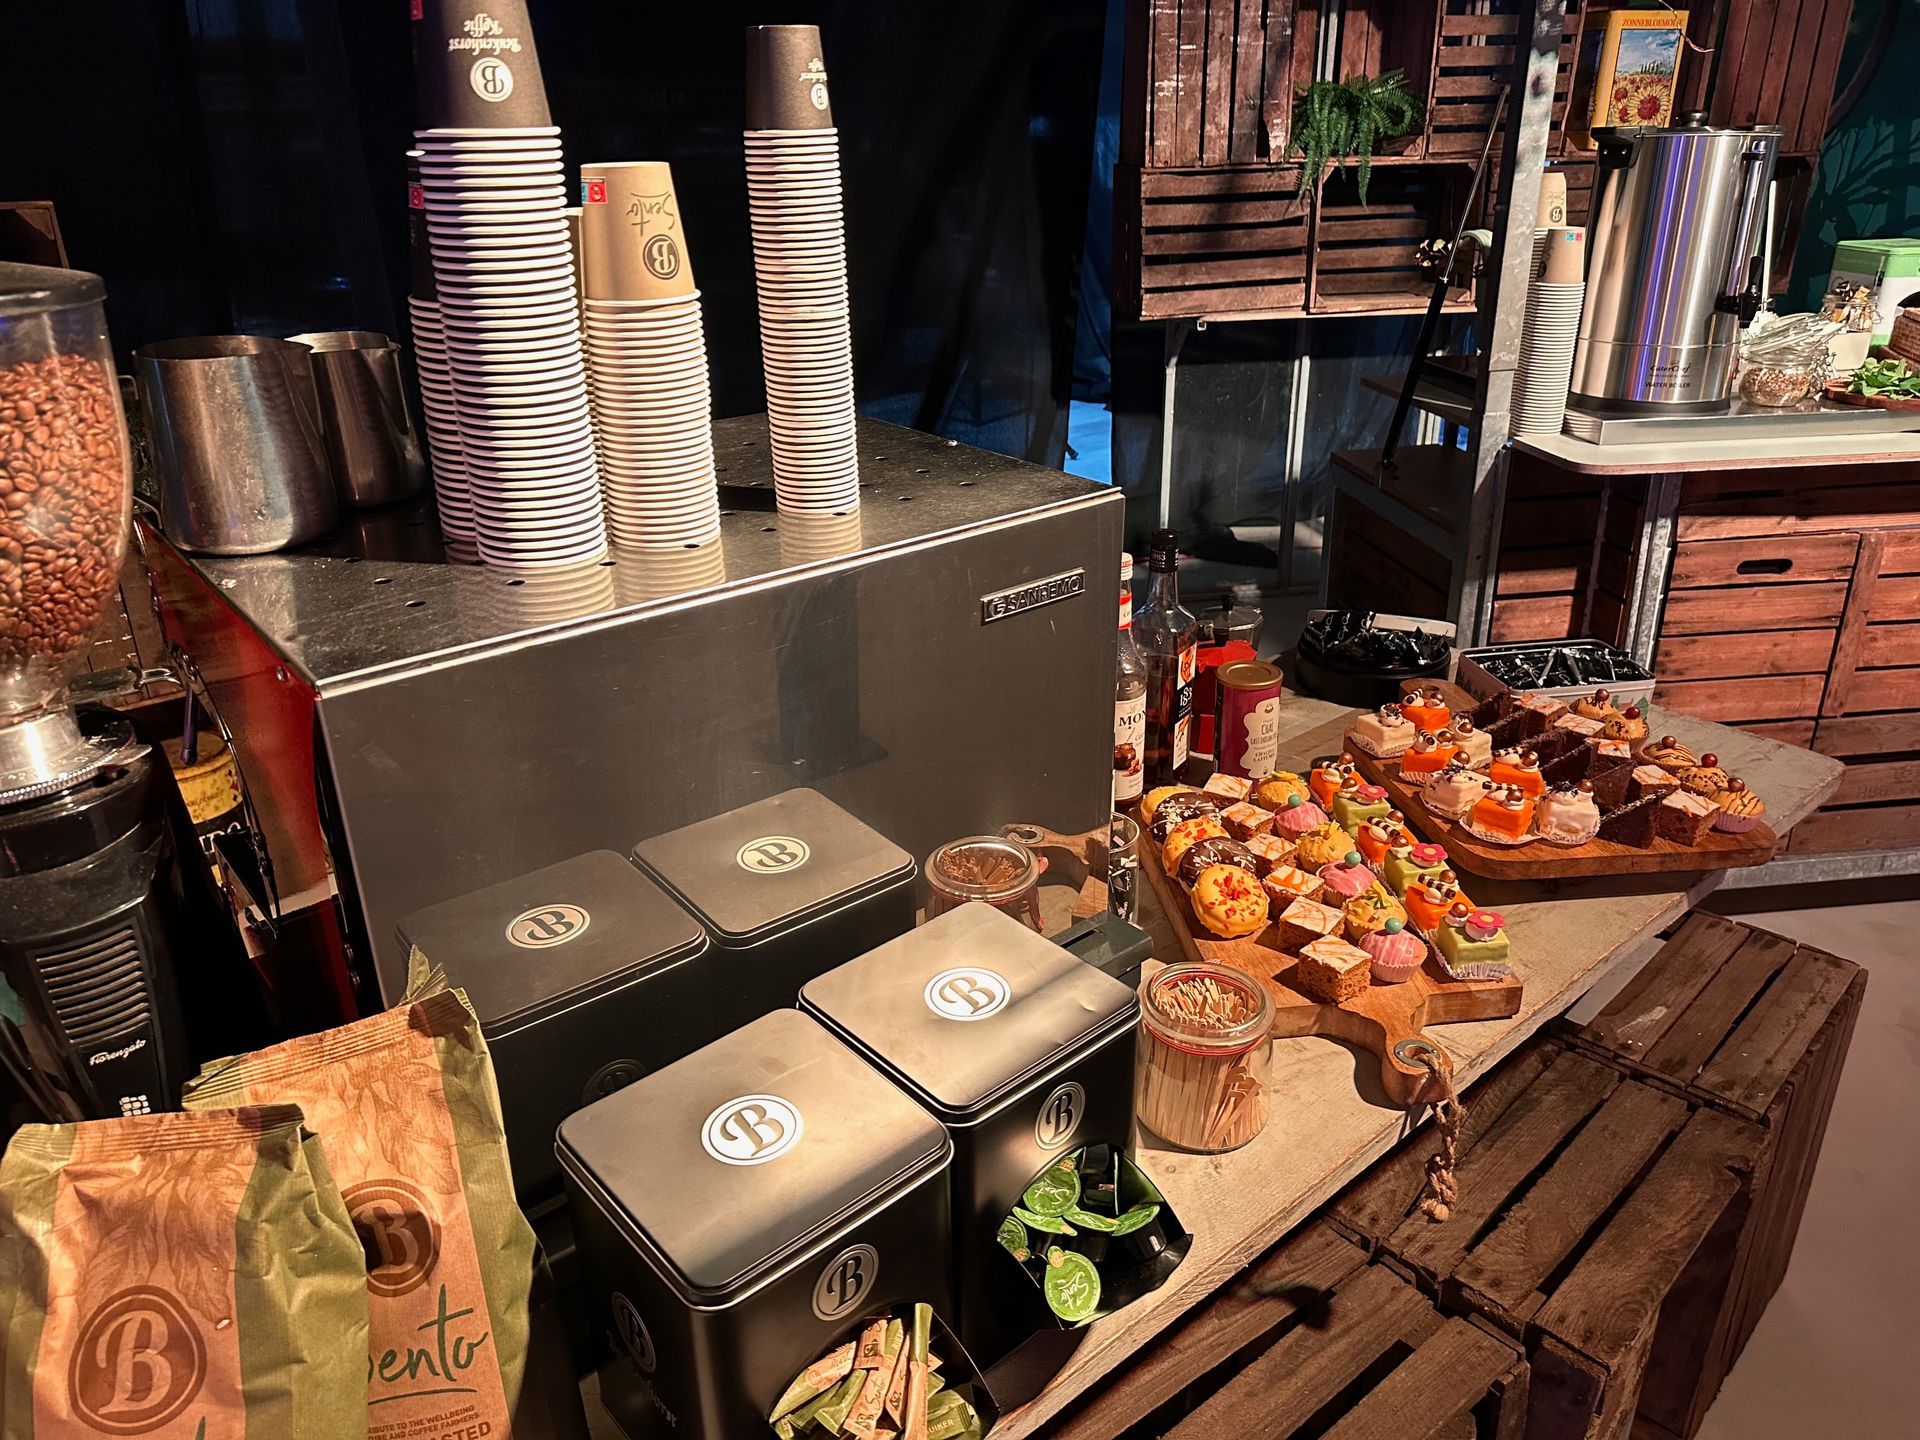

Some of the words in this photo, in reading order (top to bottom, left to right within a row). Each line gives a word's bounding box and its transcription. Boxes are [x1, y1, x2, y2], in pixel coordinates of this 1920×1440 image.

[463, 13, 504, 38] Koffie
[448, 37, 522, 55] Beukenhorst
[626, 192, 675, 237] Sento
[1650, 362, 1692, 374] CaterCef
[1008, 575, 1081, 610] SANREMO
[89, 1039, 147, 1066] Fiorenzato
[1061, 1271, 1089, 1310] Sento
[865, 1374, 885, 1410] Sento
[389, 1429, 406, 1440] AND
[407, 1424, 439, 1437] COFFEE
[440, 1411, 480, 1430] FARMERS
[397, 1422, 408, 1430] TO
[408, 1419, 425, 1427] THE
[426, 1404, 475, 1423] WELLBEING
[927, 1419, 954, 1434] UIKER
[430, 1421, 492, 1440] STED
